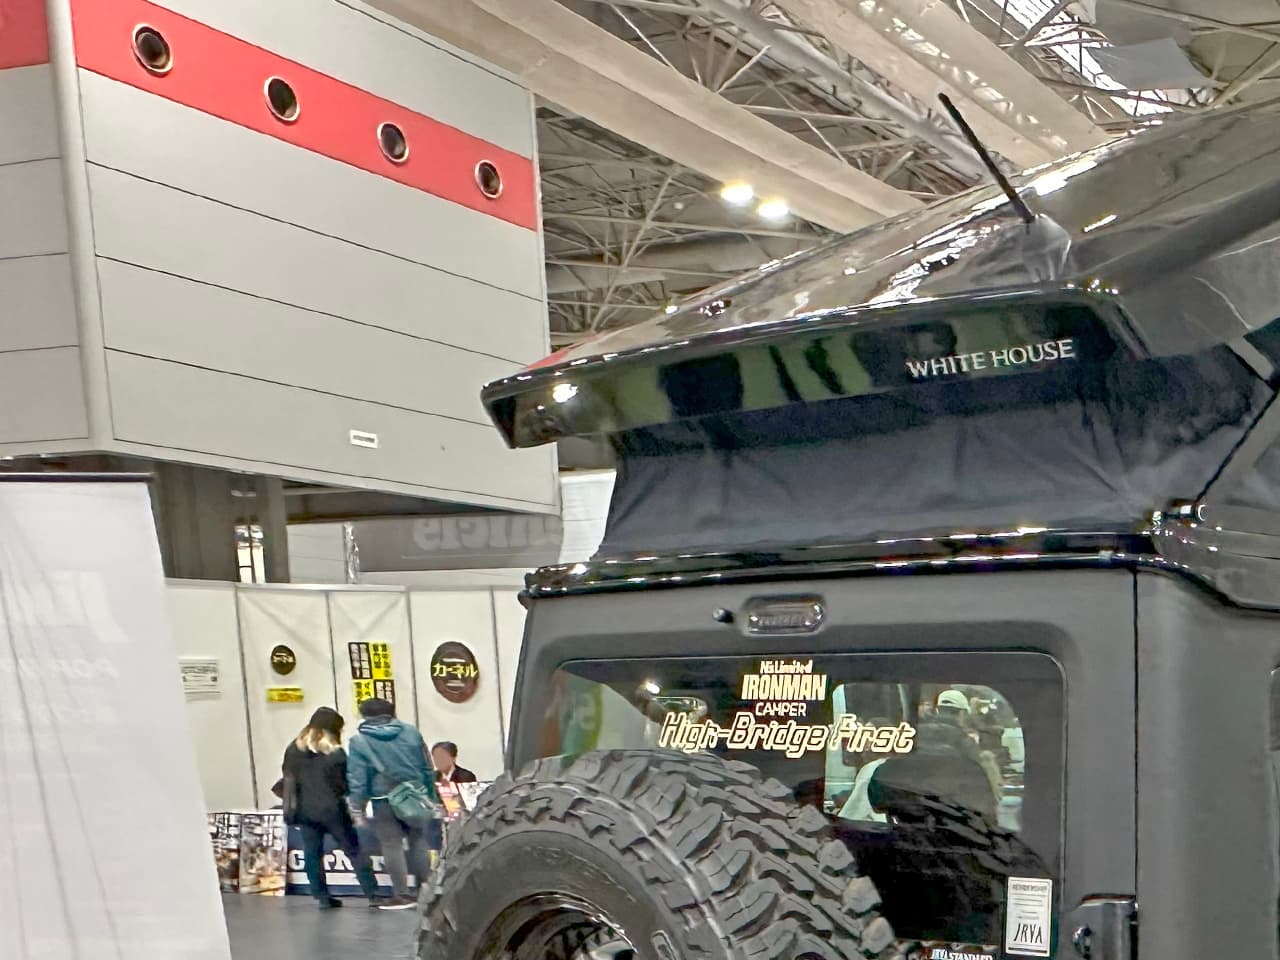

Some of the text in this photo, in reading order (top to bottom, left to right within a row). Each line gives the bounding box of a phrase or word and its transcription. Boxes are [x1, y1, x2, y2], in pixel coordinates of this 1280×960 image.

[905, 339, 1076, 378] WHITE HOUSE
[432, 662, 478, 679] カーネル
[741, 674, 827, 700] IRONMAN
[755, 702, 807, 716] CAMPER
[659, 712, 916, 758] High-Bridge First
